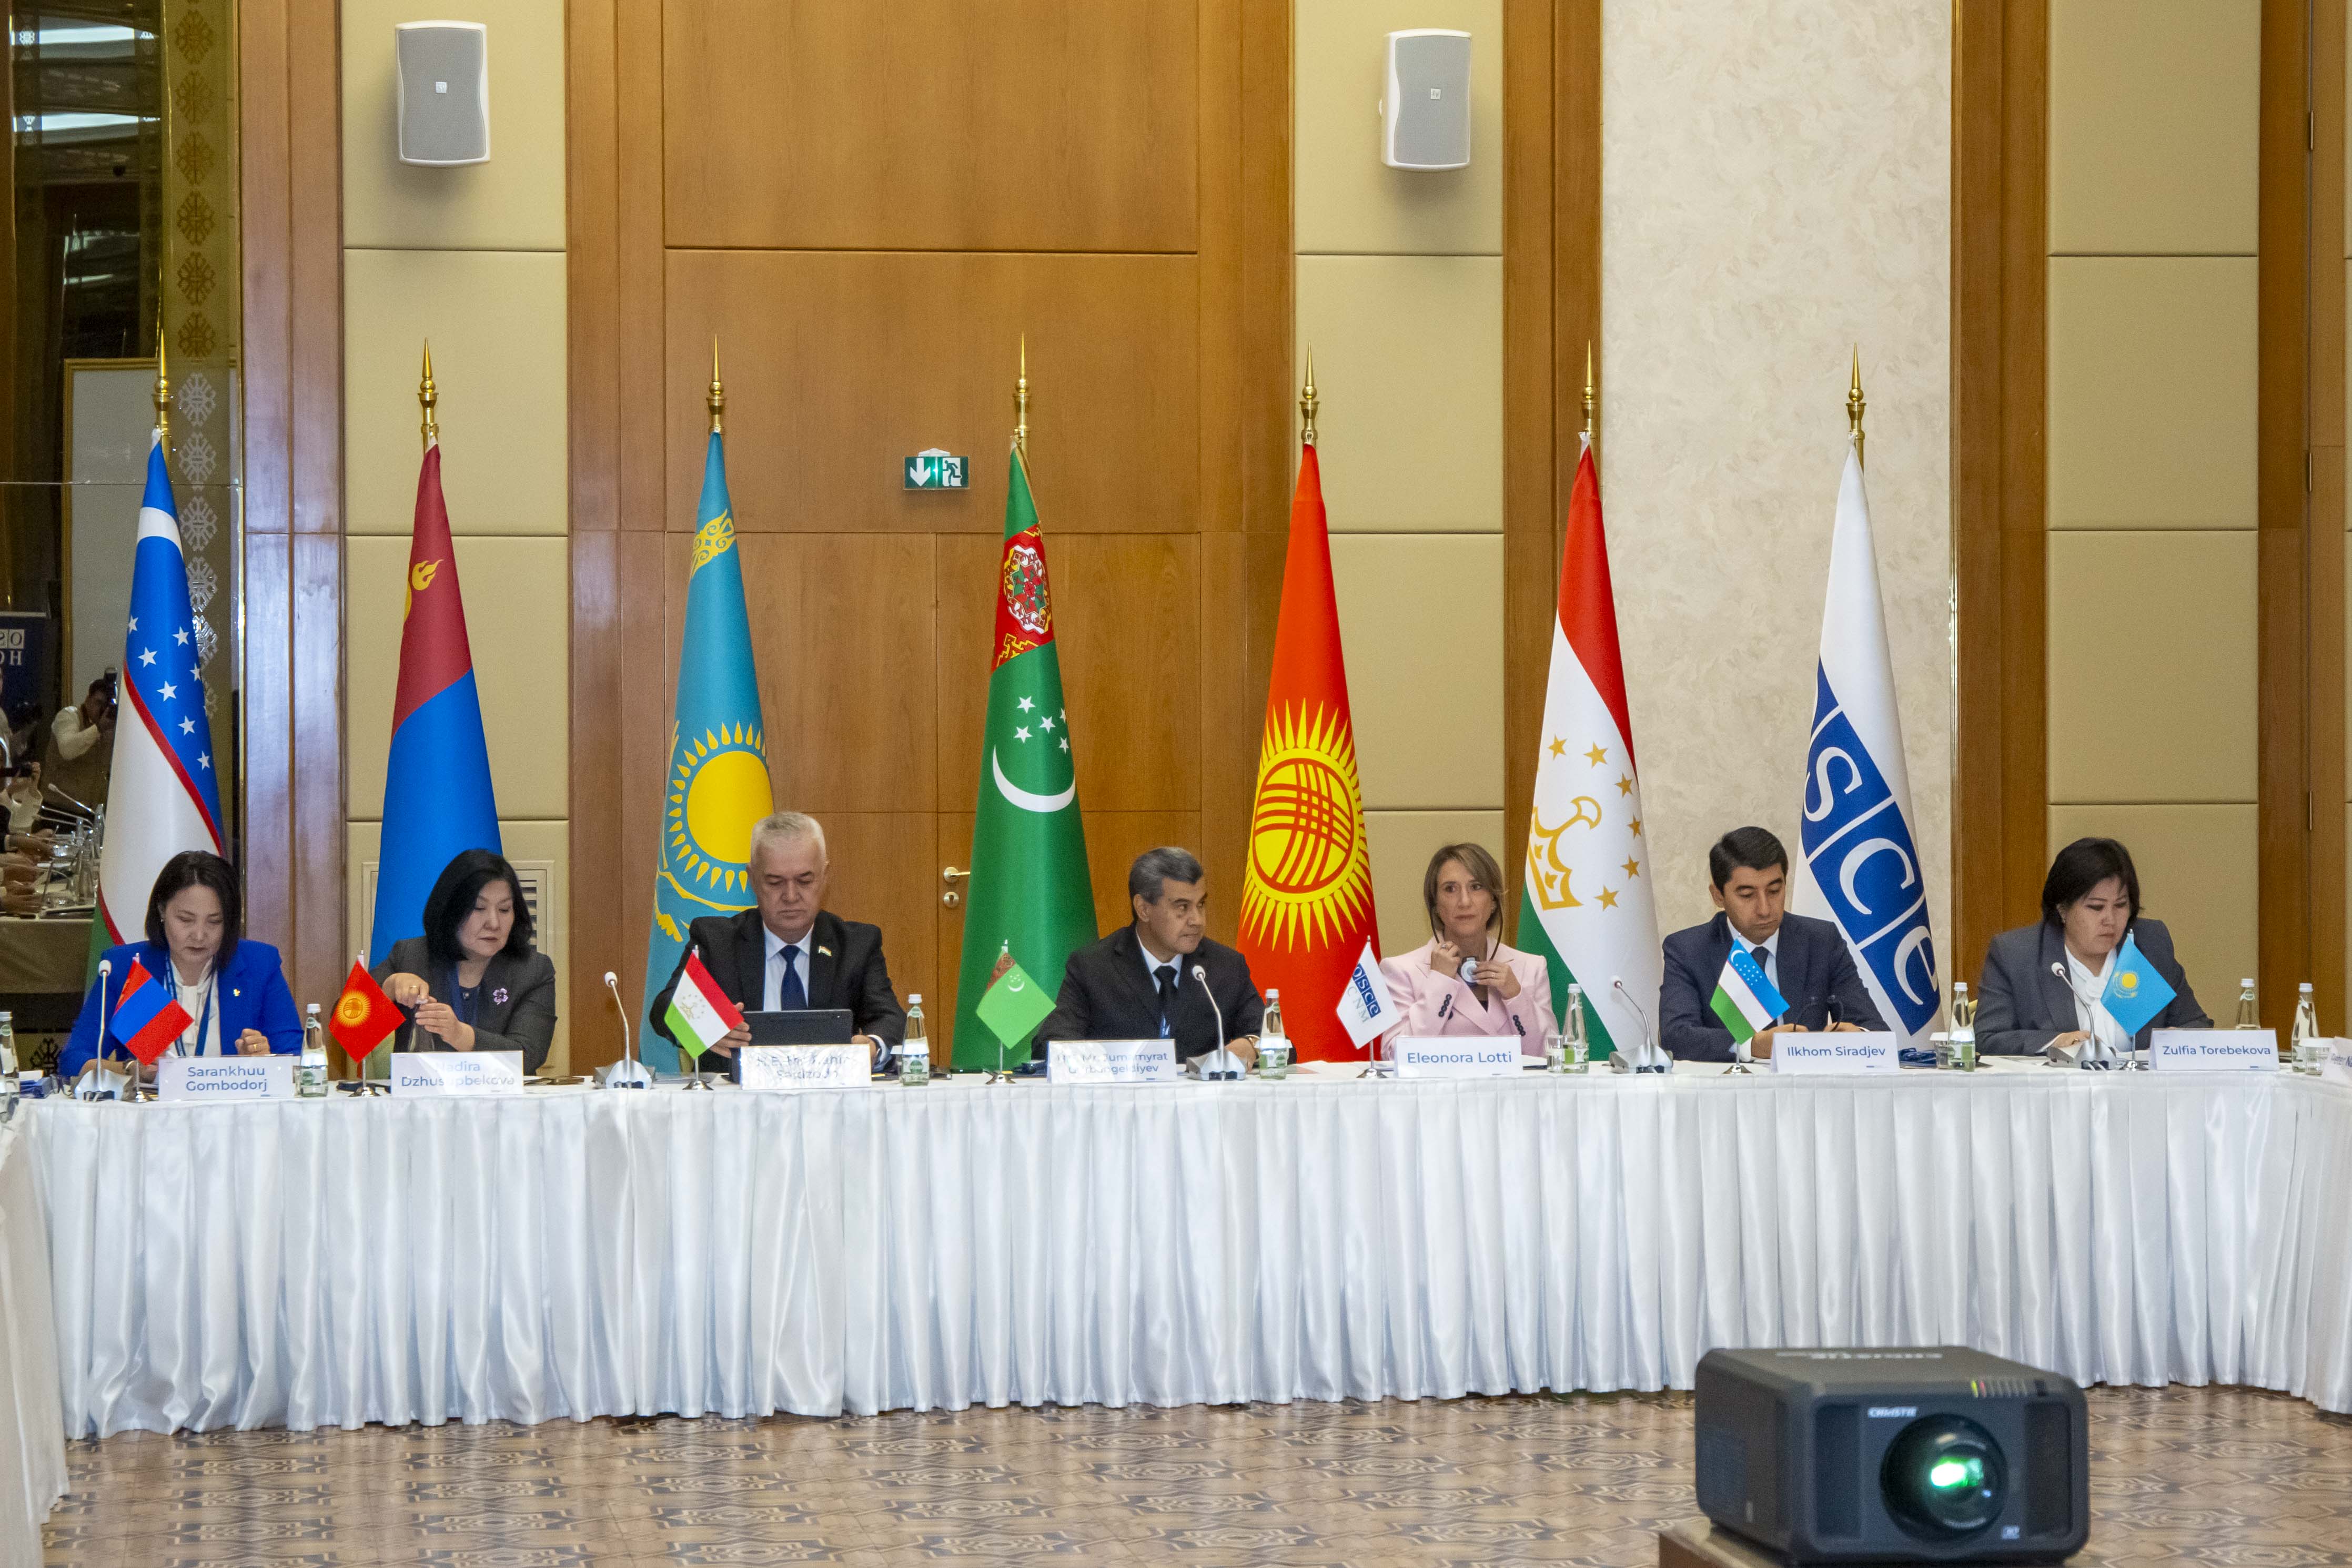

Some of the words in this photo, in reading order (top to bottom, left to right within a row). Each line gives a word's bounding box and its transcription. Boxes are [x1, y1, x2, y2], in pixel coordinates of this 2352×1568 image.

[1787, 1046, 1832, 1057] Ilkhom
[1835, 1046, 1886, 1058] Siradjev
[2162, 1045, 2197, 1055] Zulfia
[2199, 1045, 2271, 1055] Torebekova
[1407, 1052, 1473, 1063] Eleonora
[1478, 1051, 1512, 1063] Lotti
[187, 1066, 265, 1077] Sarankhuu
[186, 1079, 267, 1092] Gombodorj
[401, 1075, 514, 1087] Dzhuspbekova
